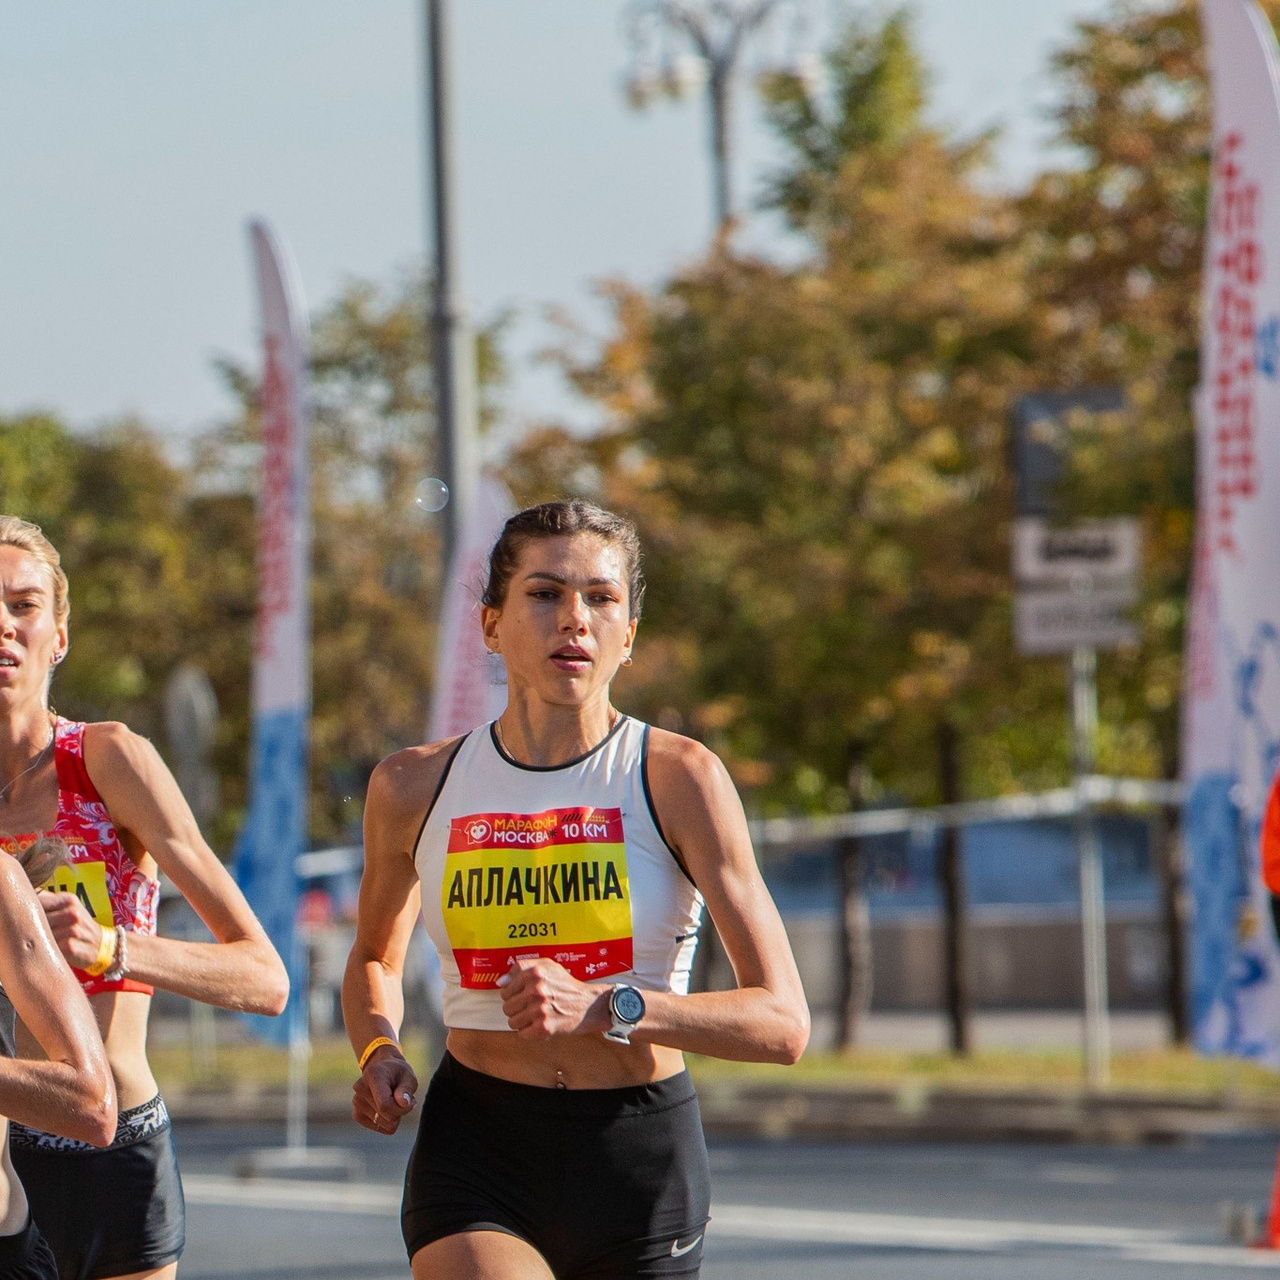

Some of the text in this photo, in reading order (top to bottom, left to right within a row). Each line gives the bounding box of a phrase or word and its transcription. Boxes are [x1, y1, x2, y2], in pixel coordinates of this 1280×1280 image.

[493, 814, 558, 831] МАРАФОН
[561, 823, 608, 839] 10 КМ
[493, 829, 550, 844] МОСКВА
[447, 861, 624, 909] АПЛАЧКИНА
[507, 922, 558, 939] 22031
